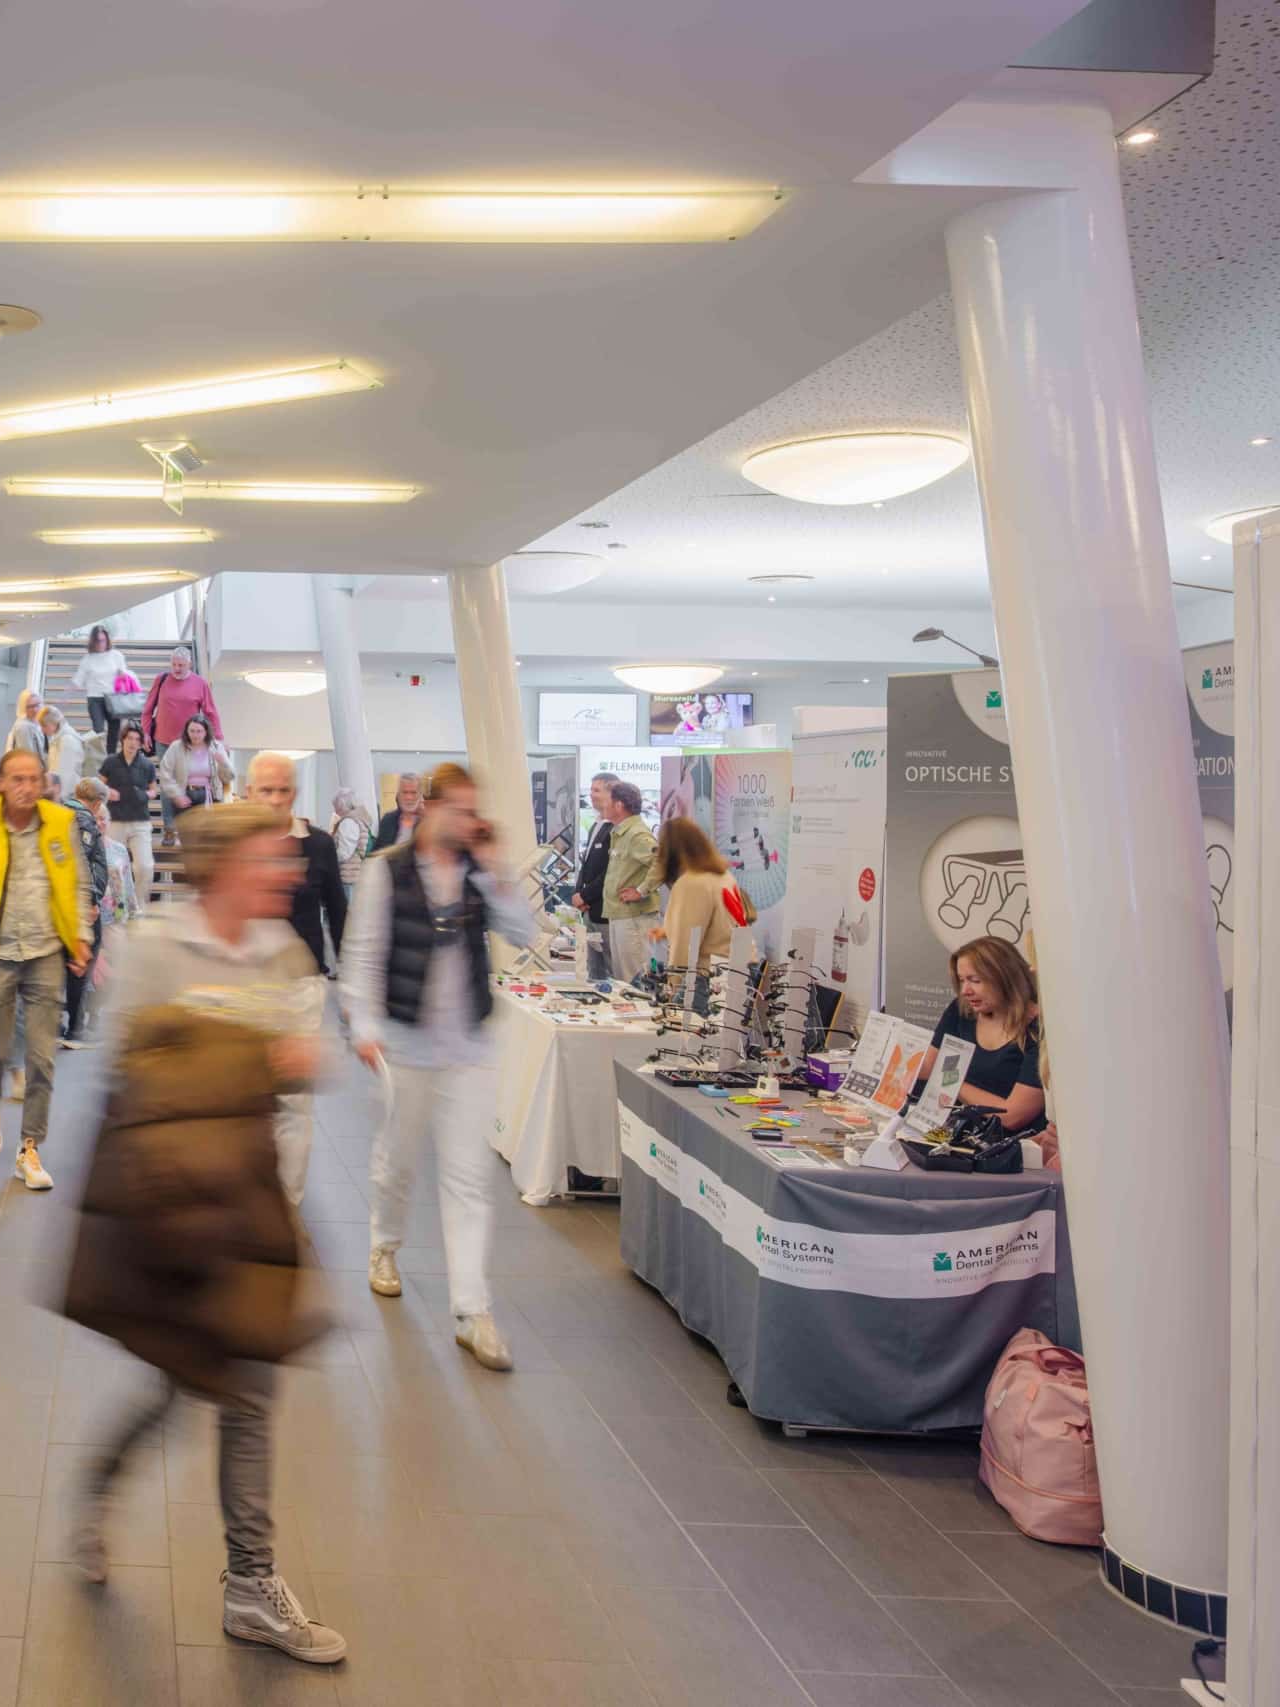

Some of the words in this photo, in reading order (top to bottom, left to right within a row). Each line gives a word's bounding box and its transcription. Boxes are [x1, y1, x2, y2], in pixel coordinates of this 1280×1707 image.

[610, 761, 660, 771] FLEMMING
[904, 765, 993, 782] OPTISCHE
[999, 765, 1010, 782] S
[736, 774, 767, 794] 1000
[761, 1231, 834, 1255] MERICAN
[782, 1249, 835, 1265] Systems
[956, 1257, 993, 1271] Dental
